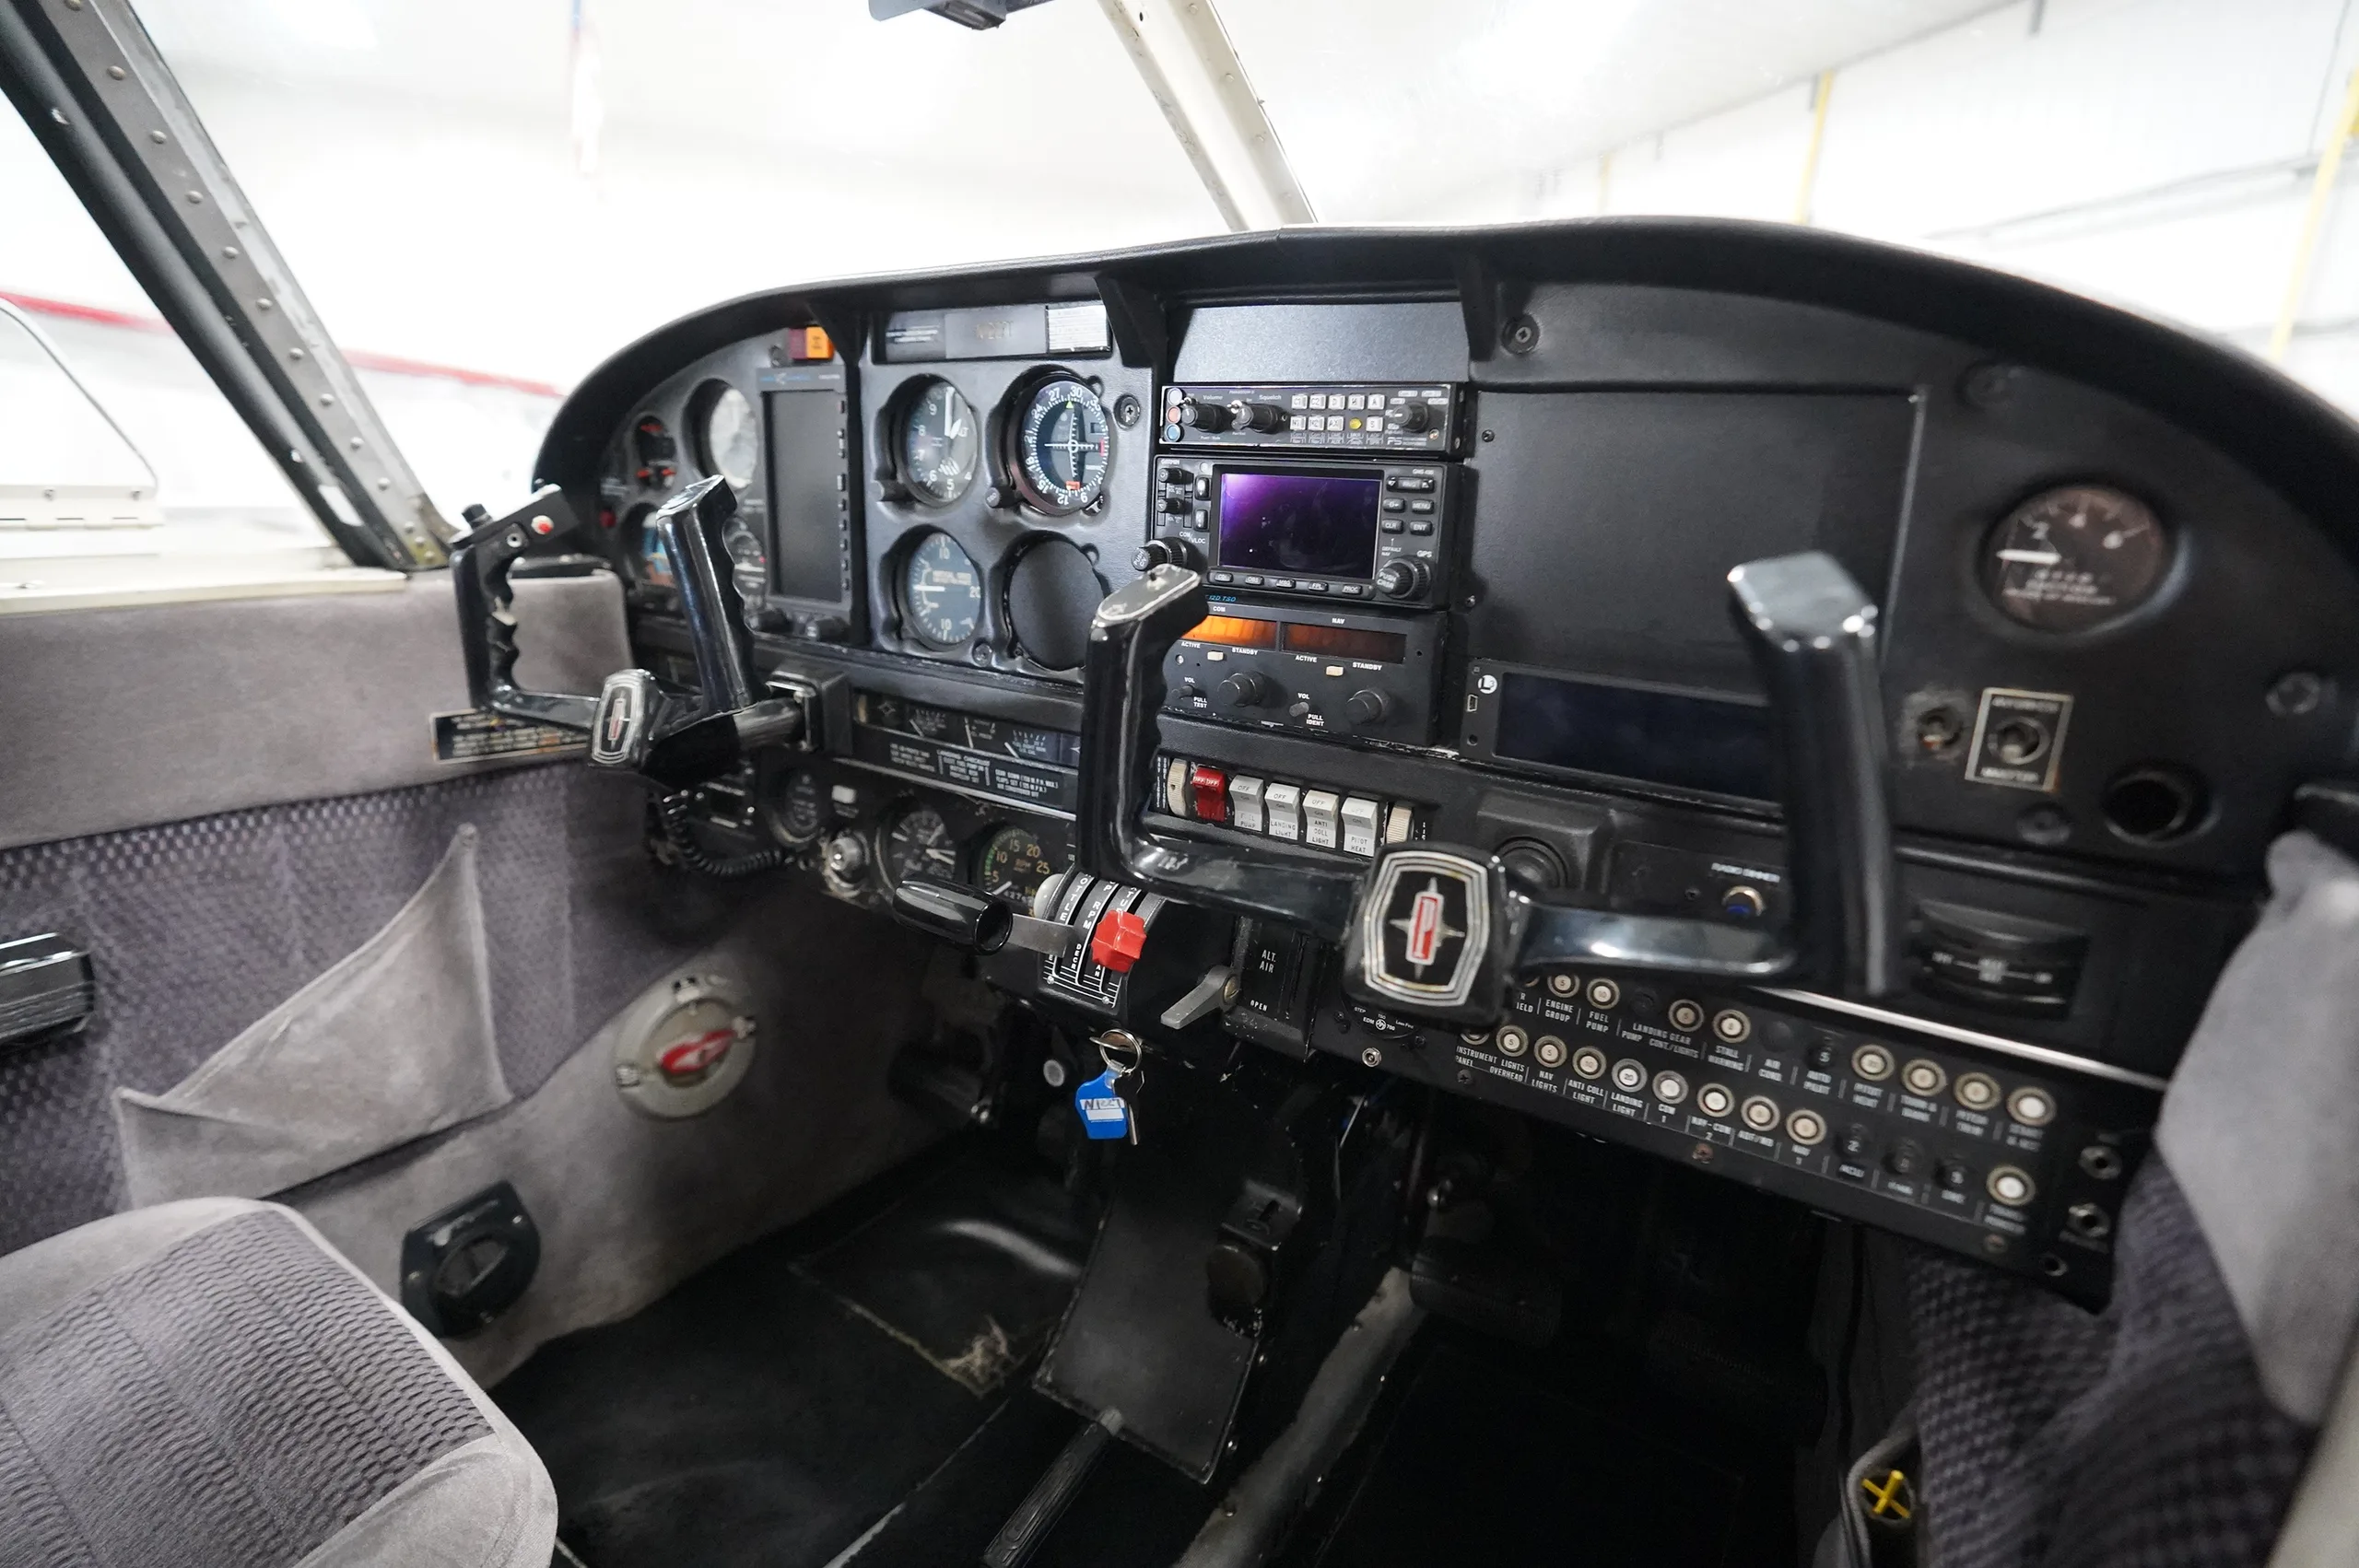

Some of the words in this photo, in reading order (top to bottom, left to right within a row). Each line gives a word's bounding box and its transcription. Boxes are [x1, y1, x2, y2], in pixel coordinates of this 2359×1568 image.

[1232, 648, 1259, 656] STANDBY
[1296, 655, 1317, 663] ACTIVE
[1353, 661, 1382, 671] STANDBY
[1271, 821, 1296, 831] LANDING
[1010, 839, 1020, 852] 15
[1312, 837, 1329, 845] LIGHT
[1026, 844, 1040, 858] 20
[1351, 845, 1366, 853] HEAT
[995, 851, 1007, 863] 10
[1036, 860, 1050, 874] 25
[992, 872, 999, 883] 5
[1060, 874, 1094, 921] OTTLE
[1083, 901, 1101, 929] RPM
[1071, 943, 1082, 969] DECR
[1262, 950, 1276, 963] ALT.
[1259, 961, 1273, 973] AIR
[1250, 1000, 1268, 1012] OPEN
[1545, 999, 1575, 1013] ENGINE
[1544, 1009, 1571, 1023] GROUP
[1590, 1011, 1610, 1023] FUEL
[1586, 1020, 1610, 1033] PUMP
[1622, 1030, 1642, 1042] PUMP
[1633, 1023, 1668, 1039] LANDING
[1669, 1033, 1691, 1045] GEAR
[1456, 1046, 1498, 1063] INSTRUMENT
[1501, 1059, 1525, 1072] LIGHTS
[1489, 1066, 1523, 1082] OVERHEAD
[1539, 1071, 1554, 1081] NAV
[1532, 1079, 1558, 1093] LIGHTS
[1567, 1079, 1584, 1090] ANTI
[1586, 1084, 1604, 1096] COLL
[1572, 1092, 1596, 1104] LIGHT
[1611, 1092, 1643, 1108] LANDING
[1613, 1104, 1636, 1117] LIGHT
[1658, 1104, 1675, 1115] COM
